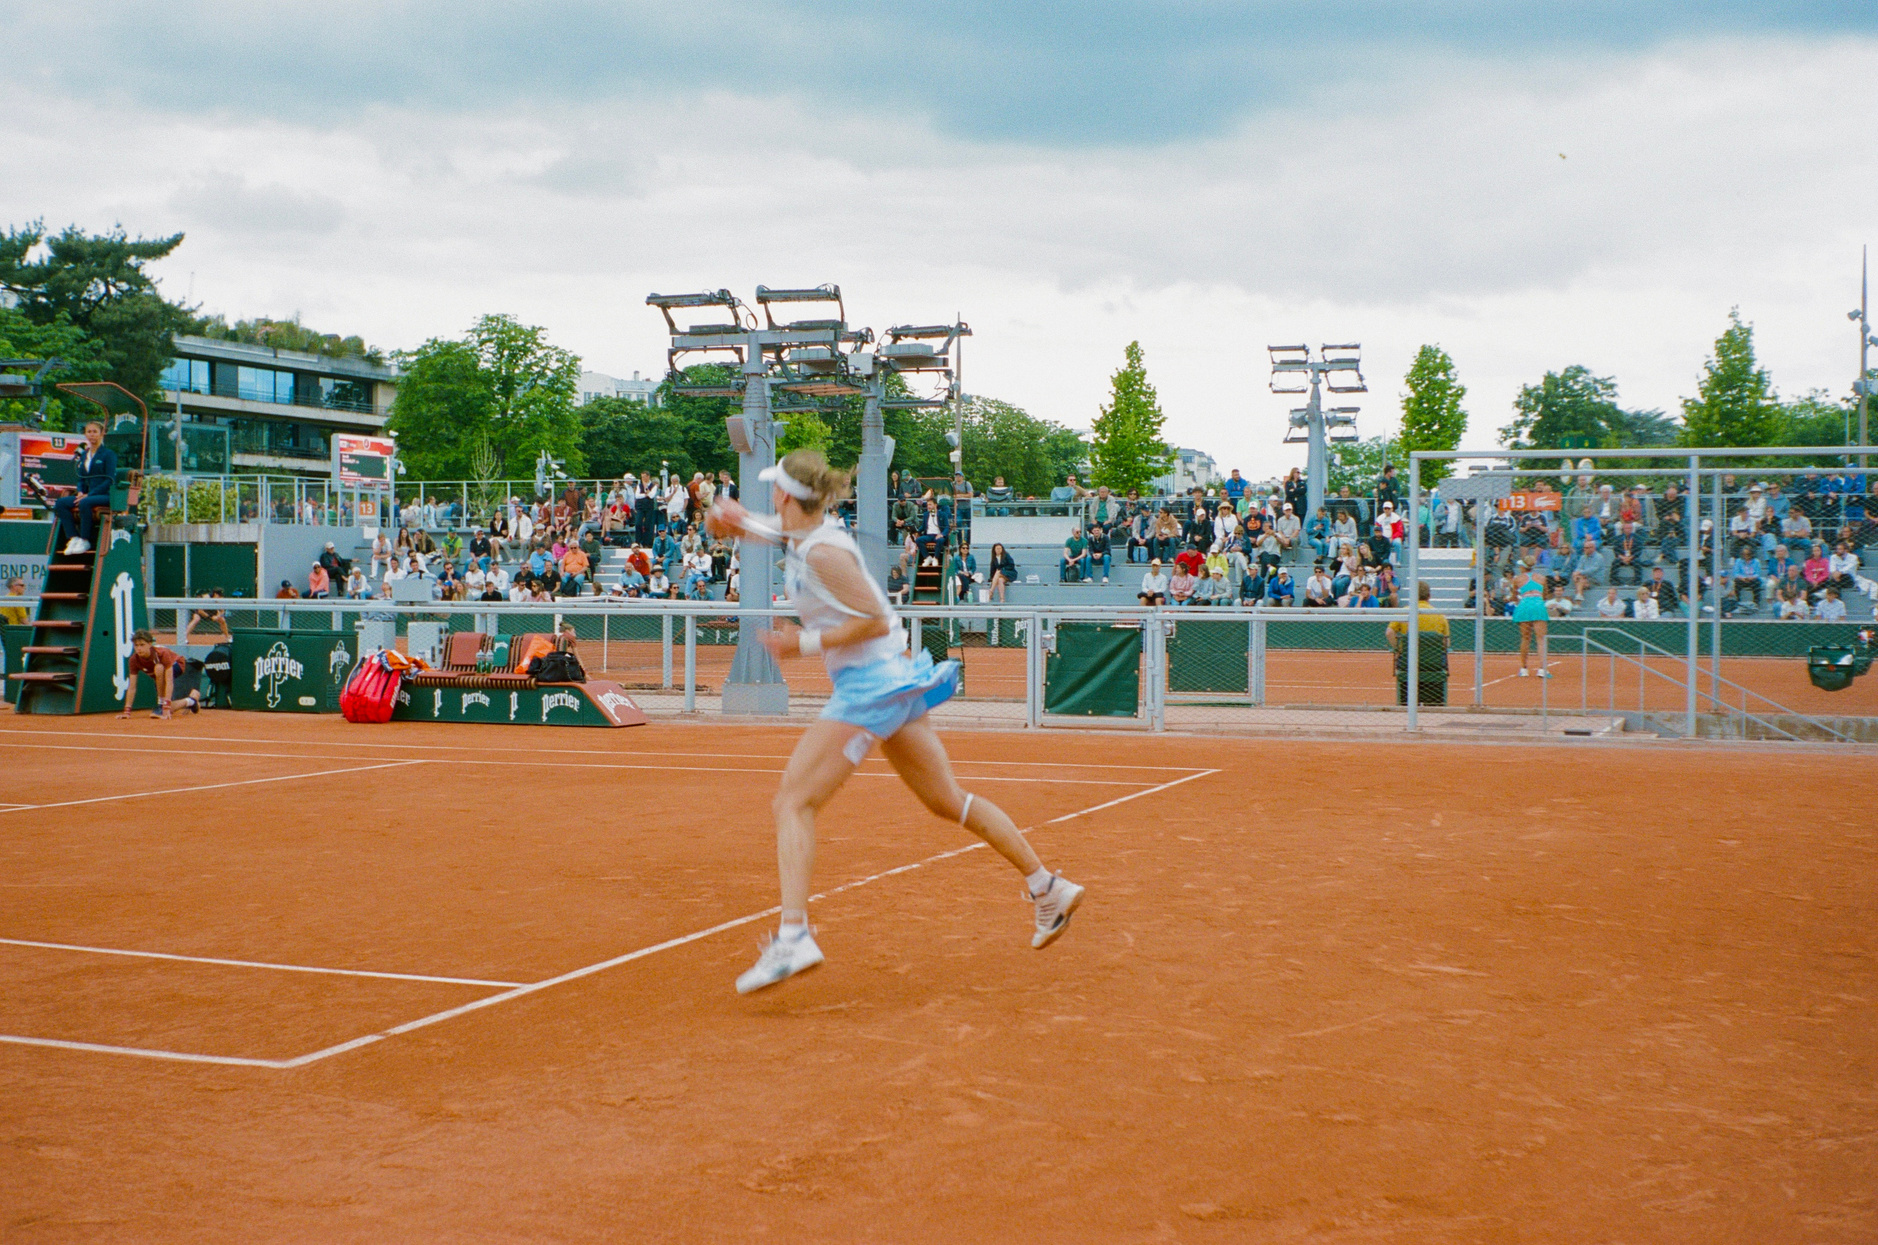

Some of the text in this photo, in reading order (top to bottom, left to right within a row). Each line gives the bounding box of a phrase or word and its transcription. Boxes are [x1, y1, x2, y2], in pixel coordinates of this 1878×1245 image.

[361, 503, 373, 514] 13
[0, 564, 28, 580] BNP
[254, 653, 304, 692] perrier
[461, 690, 491, 715] perrier
[541, 690, 580, 722] perrier
